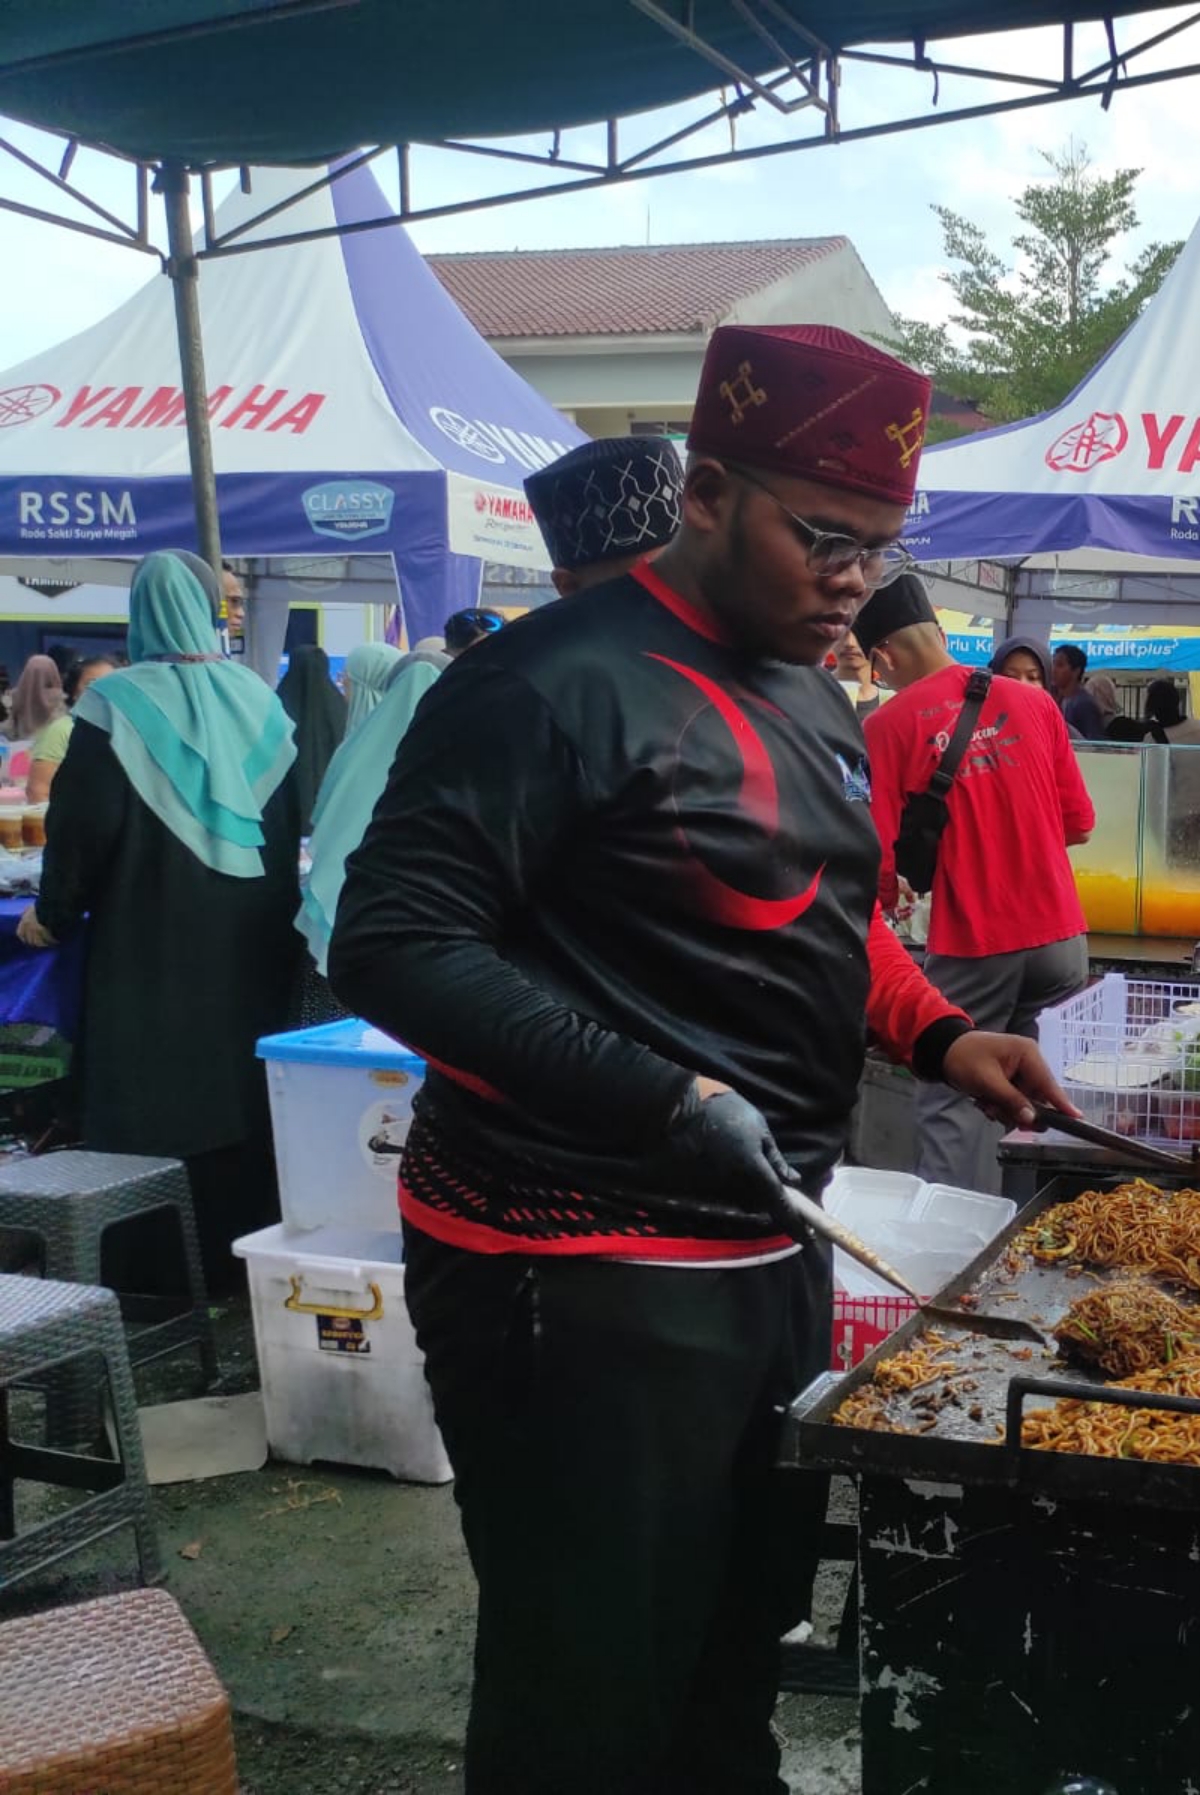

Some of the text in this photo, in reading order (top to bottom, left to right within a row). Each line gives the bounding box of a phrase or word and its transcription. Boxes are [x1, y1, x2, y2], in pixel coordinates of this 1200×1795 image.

[20, 491, 136, 525] RSSM
[308, 492, 386, 512] CLASSY
[1171, 528, 1199, 541] Roda
[1087, 640, 1172, 659] kreditplus
